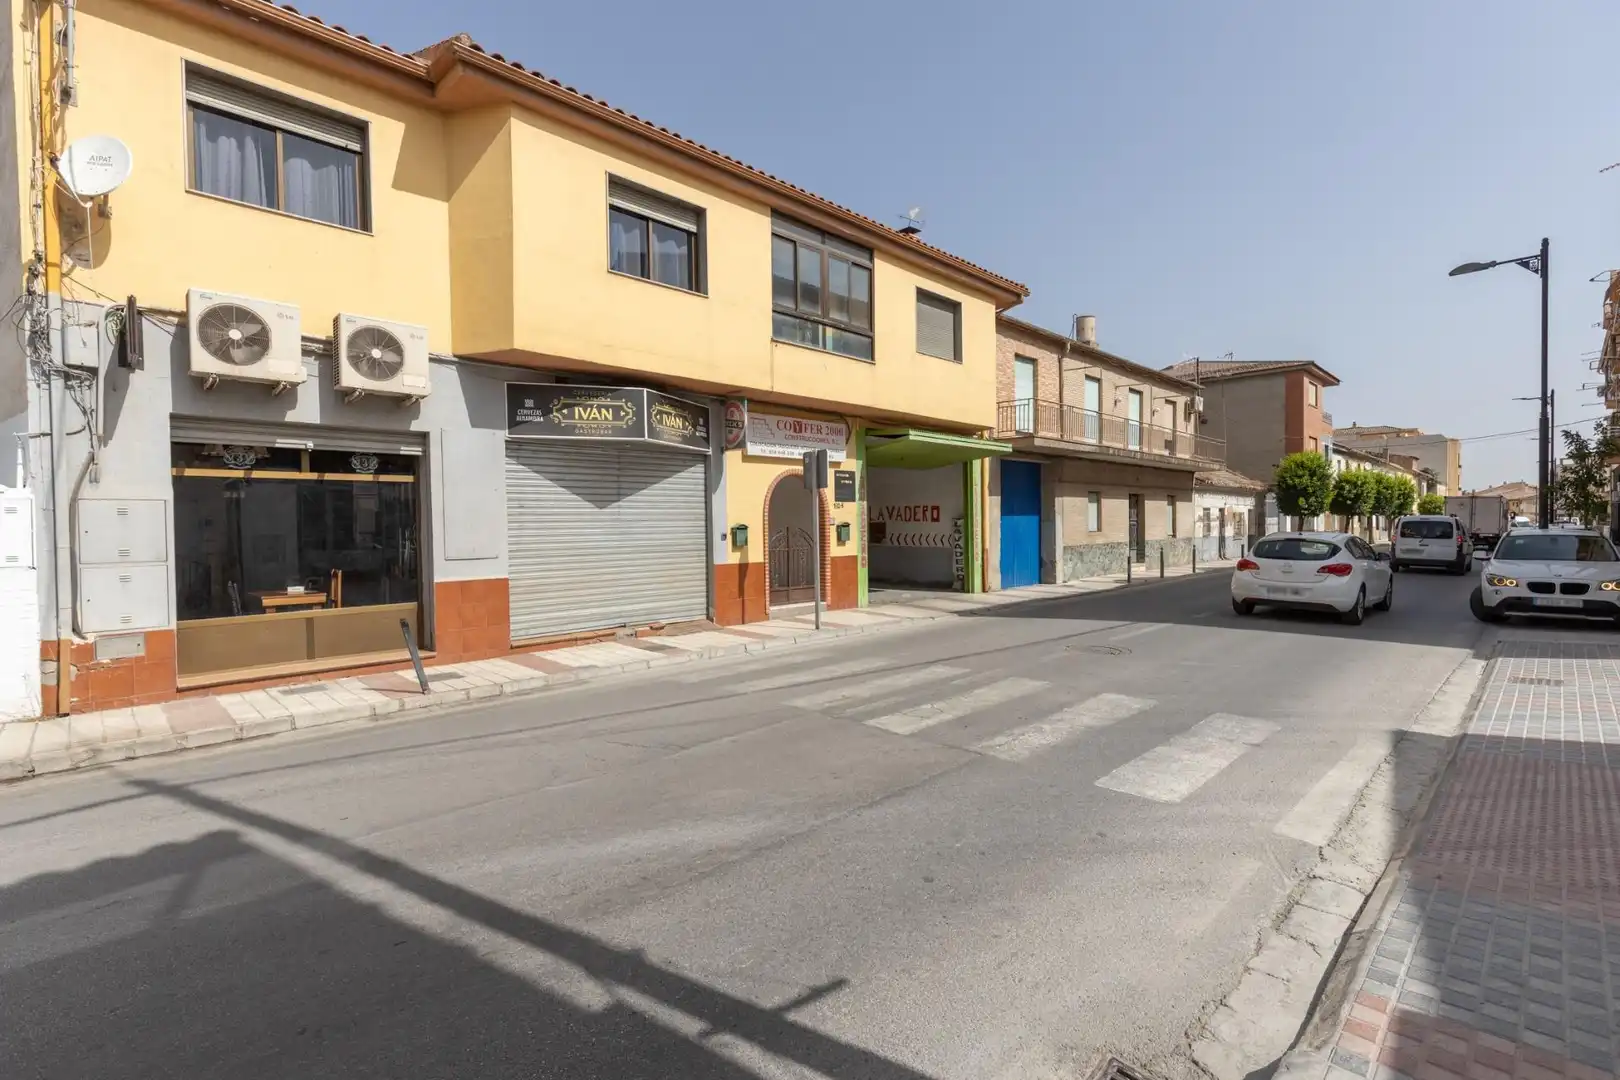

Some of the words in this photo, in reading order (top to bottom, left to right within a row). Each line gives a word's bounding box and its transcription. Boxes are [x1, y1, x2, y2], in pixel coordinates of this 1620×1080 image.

[517, 409, 542, 417] CERVEZAS
[574, 404, 613, 421] IVÁN
[662, 411, 683, 429] IVÁN
[869, 505, 940, 522] LAVADERO
[953, 520, 965, 583] LAVADERO
